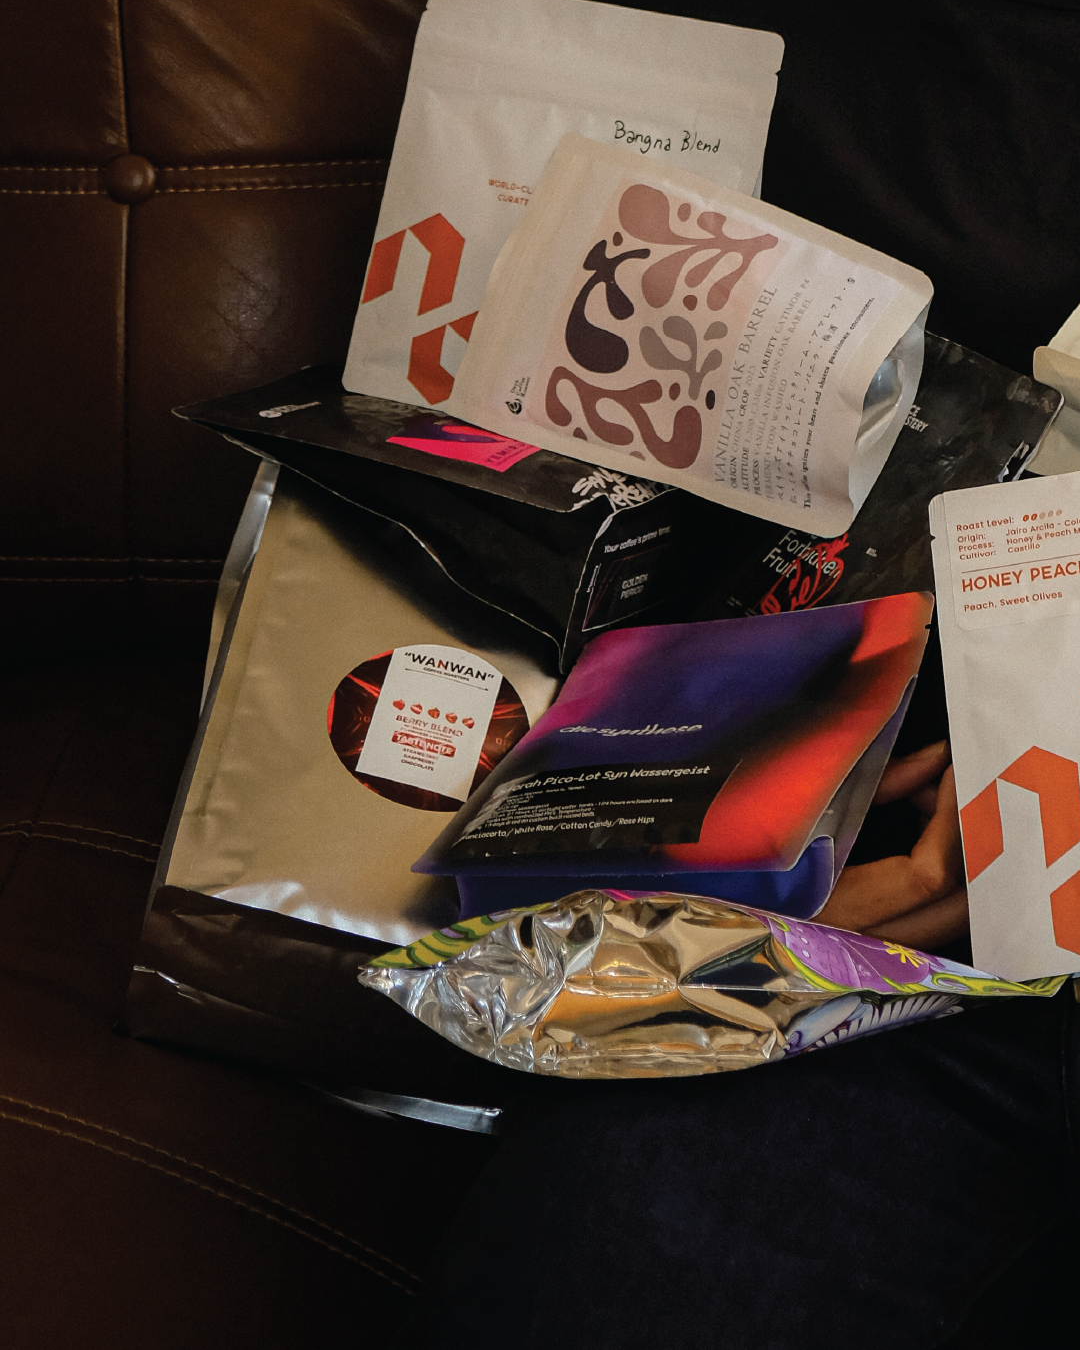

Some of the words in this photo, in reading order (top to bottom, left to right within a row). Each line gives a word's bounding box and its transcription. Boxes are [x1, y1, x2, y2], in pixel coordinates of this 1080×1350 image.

[614, 120, 671, 154] Bangna
[680, 130, 721, 154] Blend
[758, 335, 778, 380] VARIETY
[775, 290, 801, 335] CATIMOR
[715, 407, 736, 483] VANILLA
[728, 360, 745, 400] OAK
[738, 287, 778, 354] BARREL
[739, 389, 750, 417] CROP
[814, 390, 822, 406] and
[956, 521, 984, 532] Roast
[986, 516, 1015, 527] Level:
[957, 533, 986, 544] Origin:
[1005, 527, 1028, 537] Jairo
[1030, 523, 1055, 533] Arcila
[958, 541, 995, 552] Process:
[1006, 535, 1034, 545] Honey
[1036, 533, 1042, 541] &
[1044, 528, 1071, 539] Peach
[762, 547, 798, 578] Fruit
[959, 550, 997, 561] Cultivar:
[1007, 543, 1041, 554] Castillo
[962, 570, 1023, 593] HONEY
[964, 601, 997, 612] Peach,
[999, 595, 1030, 606] Sweet
[1032, 591, 1063, 602] Olives
[395, 714, 428, 729] BERRY
[430, 723, 463, 737] BLEND
[396, 734, 423, 749] TASTE
[543, 771, 601, 786] Pico-Lot
[602, 770, 628, 781] Syn
[629, 765, 711, 778] Wassergeist
[460, 830, 507, 841] ranciacorta
[637, 816, 655, 825] Hips
